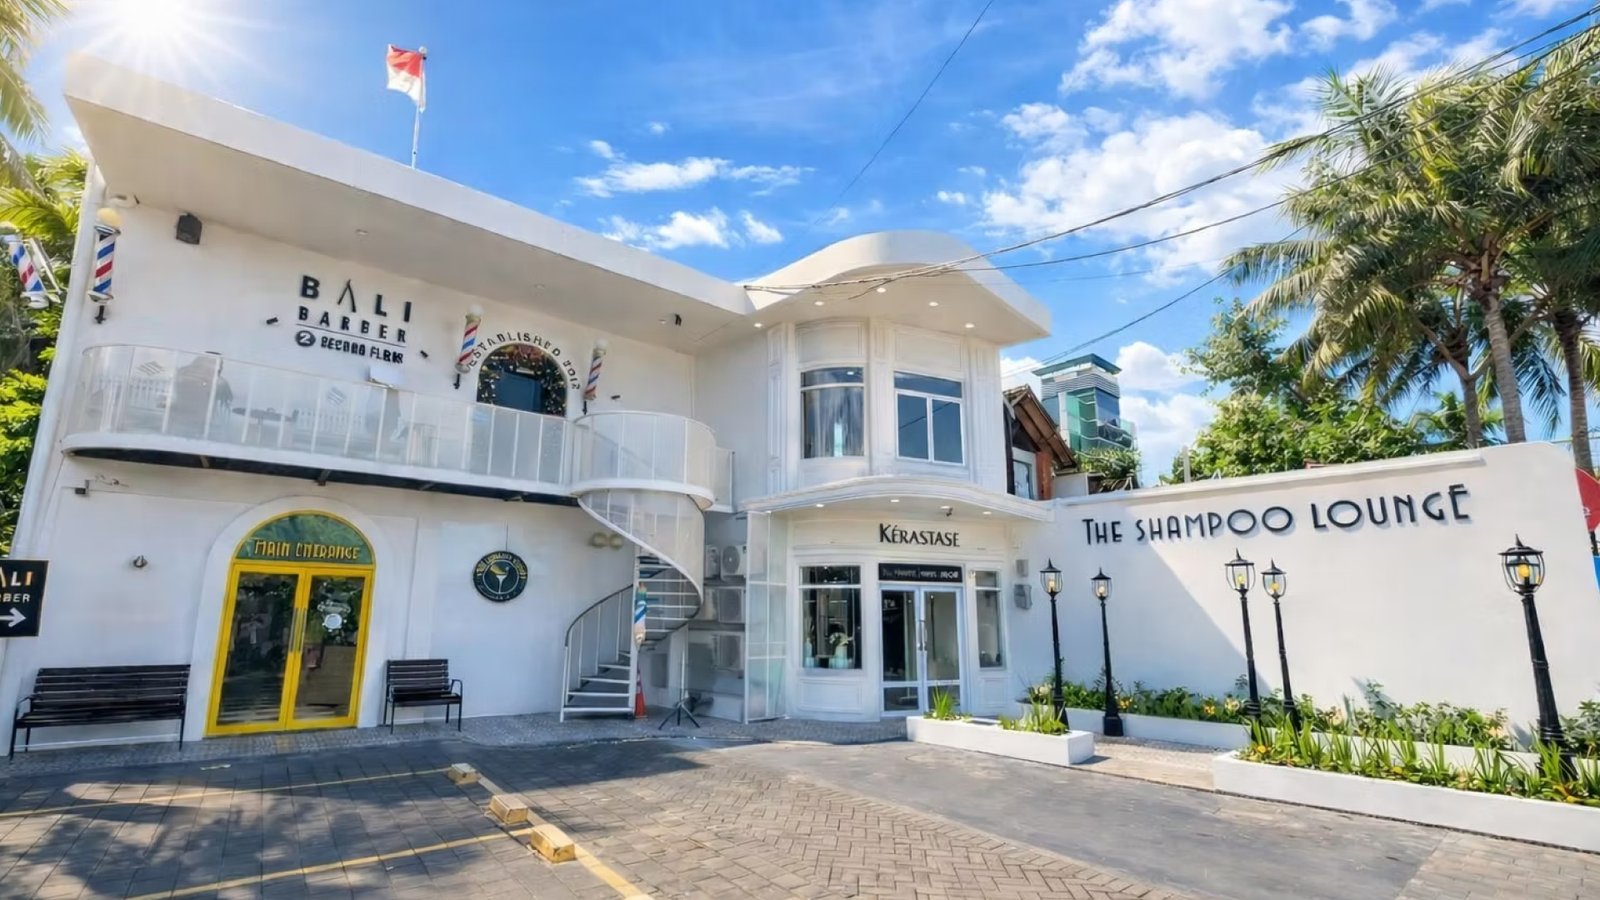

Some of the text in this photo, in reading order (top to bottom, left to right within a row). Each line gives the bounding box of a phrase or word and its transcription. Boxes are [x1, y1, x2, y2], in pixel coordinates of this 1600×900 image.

[301, 275, 412, 323] BALI
[299, 305, 406, 343] BARBER
[1082, 484, 1469, 545] THE SHAMPOO LOUNGE
[254, 540, 290, 558] MAIN
[879, 523, 961, 548] KÉRASTASE
[0, 593, 31, 603] BER
